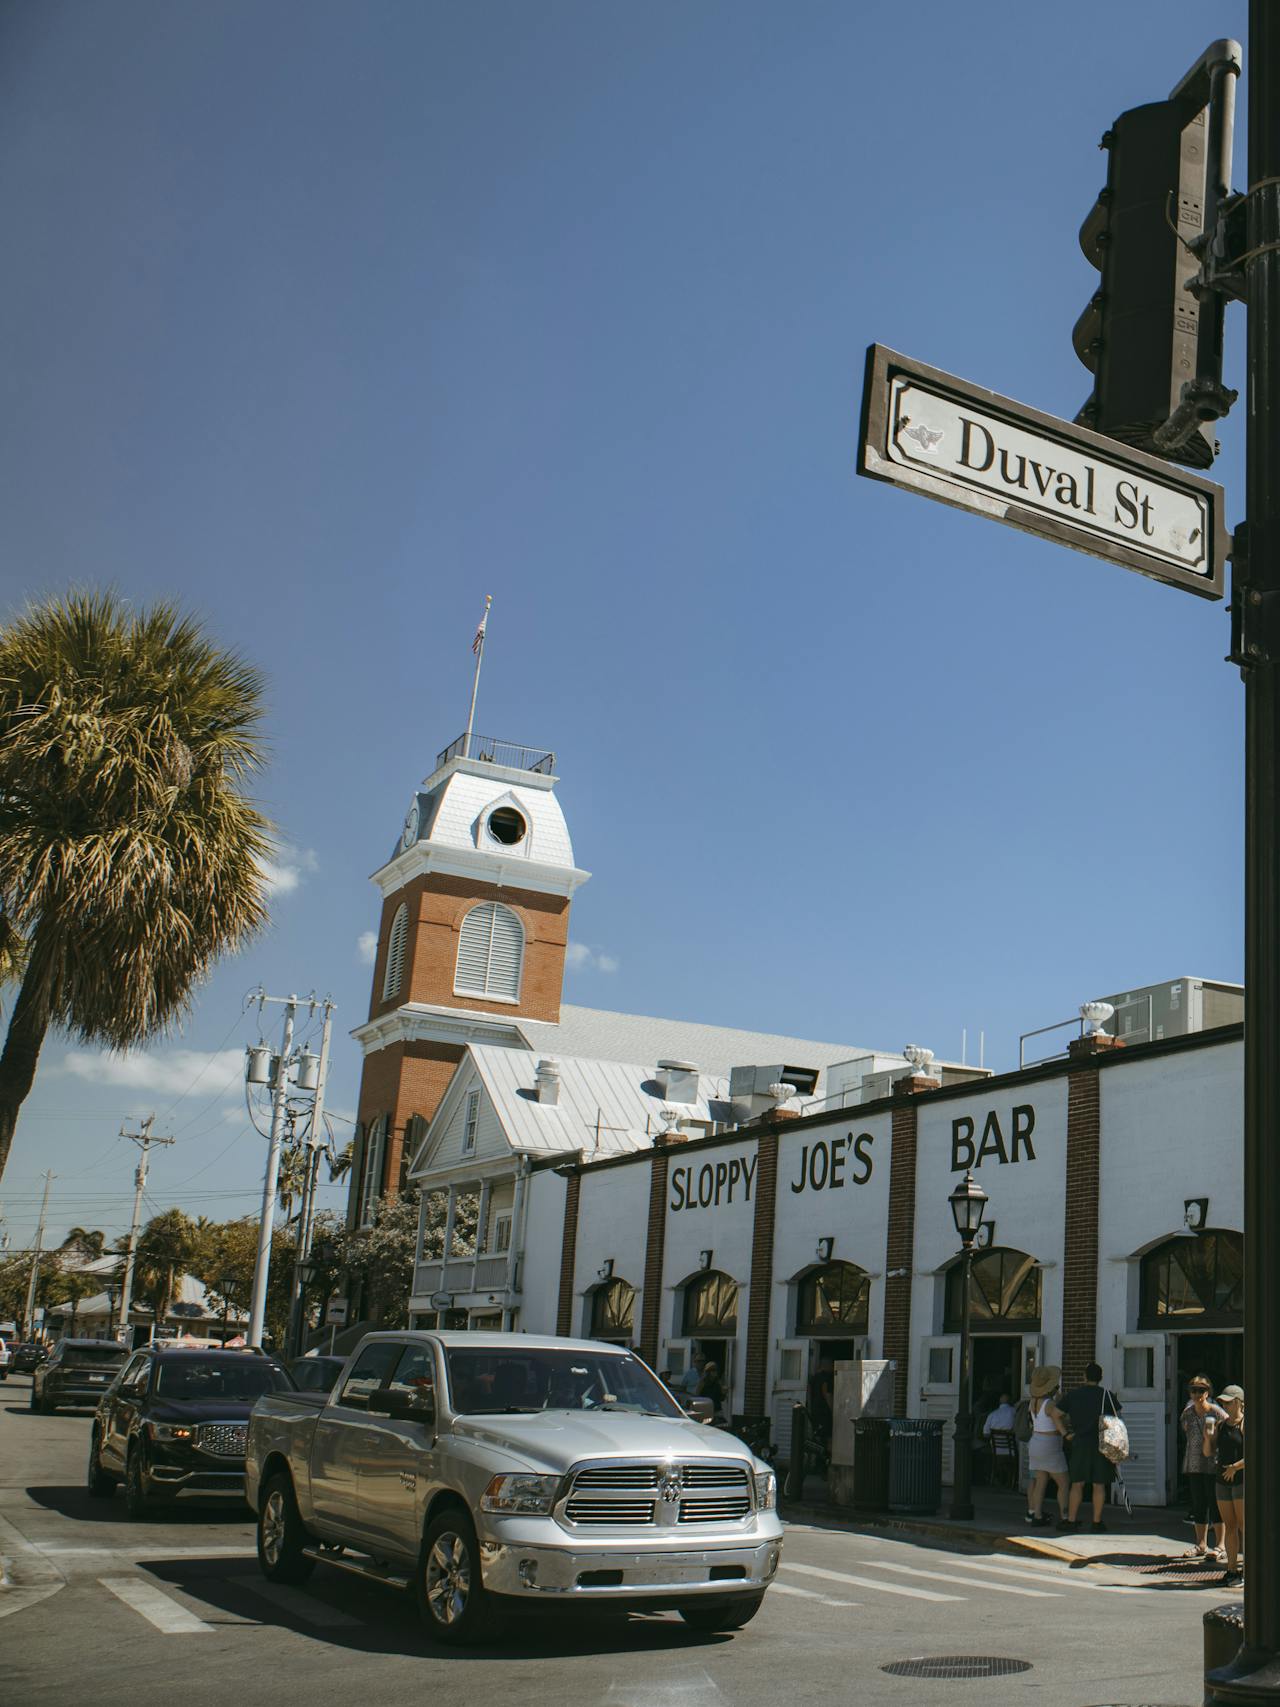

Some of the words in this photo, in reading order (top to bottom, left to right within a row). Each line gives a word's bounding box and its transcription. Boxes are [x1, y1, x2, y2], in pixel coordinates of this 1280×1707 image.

[955, 416, 1097, 515] Duval
[1115, 481, 1154, 537] St
[670, 1153, 758, 1212] SLOPPY
[791, 1131, 875, 1194] JOE'S
[950, 1104, 1036, 1173] BAR
